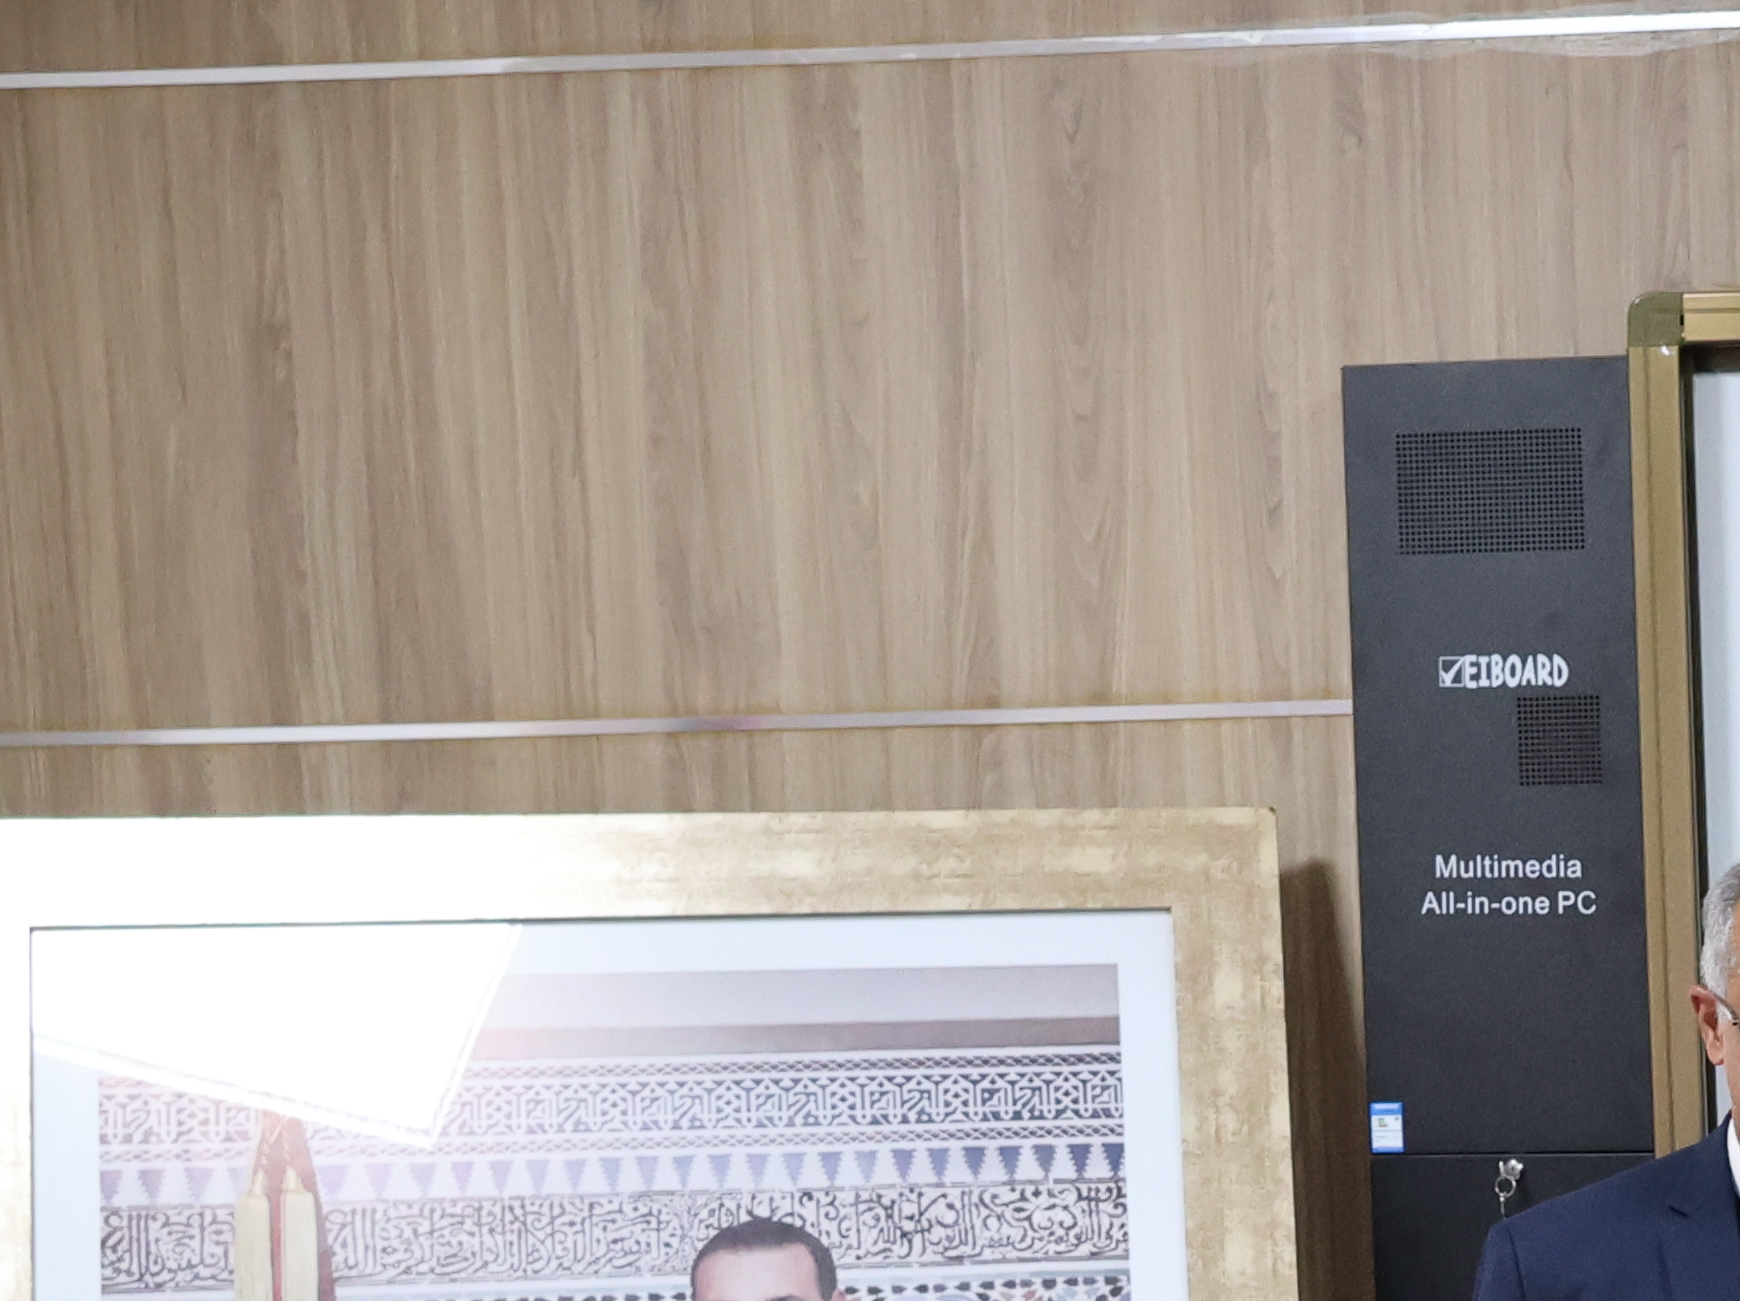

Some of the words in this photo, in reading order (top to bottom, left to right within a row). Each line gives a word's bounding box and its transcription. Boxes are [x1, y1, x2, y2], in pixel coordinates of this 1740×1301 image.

[1435, 855, 1582, 879] Multimedia
[1421, 891, 1550, 915] All-in-one
[1557, 891, 1597, 914] PC
